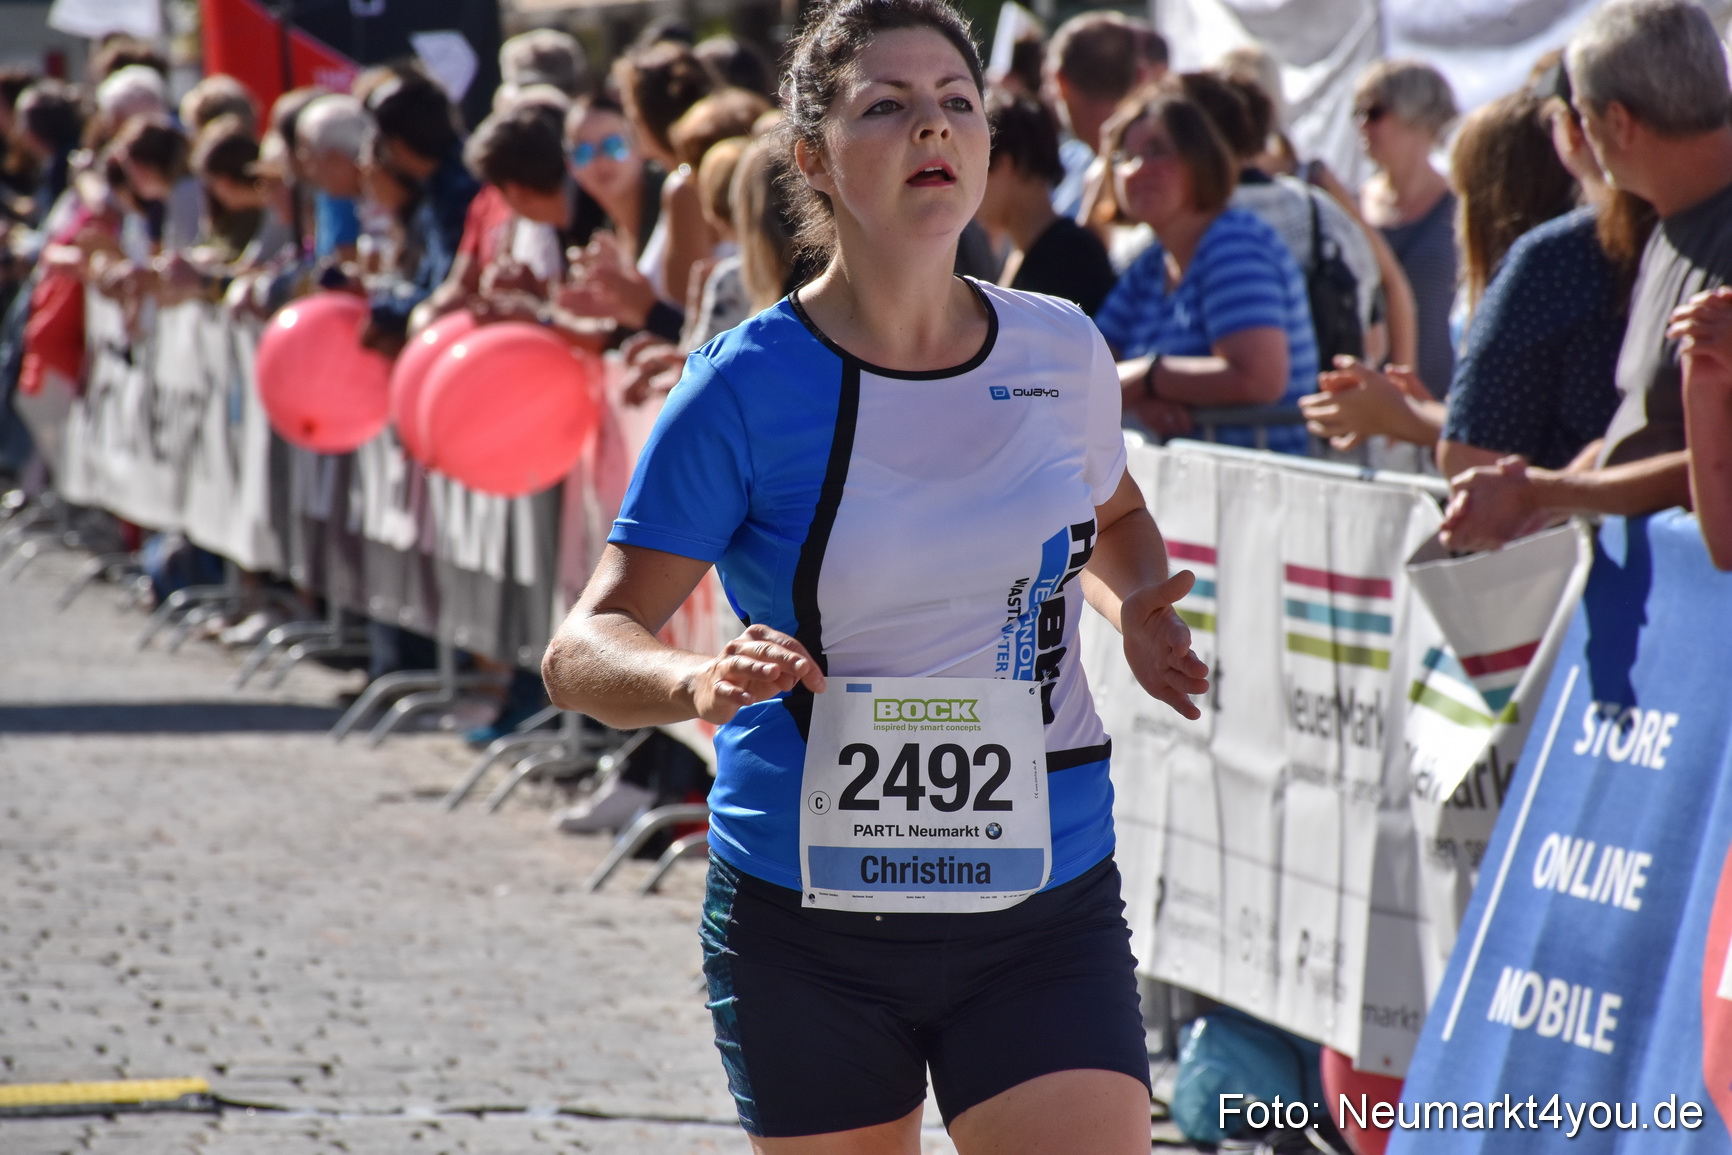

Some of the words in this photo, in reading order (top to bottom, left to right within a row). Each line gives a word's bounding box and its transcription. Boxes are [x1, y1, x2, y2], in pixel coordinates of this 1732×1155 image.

[874, 699, 980, 722] BOCK
[873, 723, 906, 732] inspired
[908, 724, 918, 732] by
[946, 724, 982, 732] concepts
[1573, 700, 1680, 770] STORE
[838, 743, 1013, 812] 2492
[815, 797, 823, 809] C
[854, 825, 905, 837] PARTL
[908, 825, 980, 838] Neumarkt
[860, 855, 992, 885] Christina
[1532, 833, 1654, 912] ONLINE
[1487, 966, 1623, 1054] MOBILE
